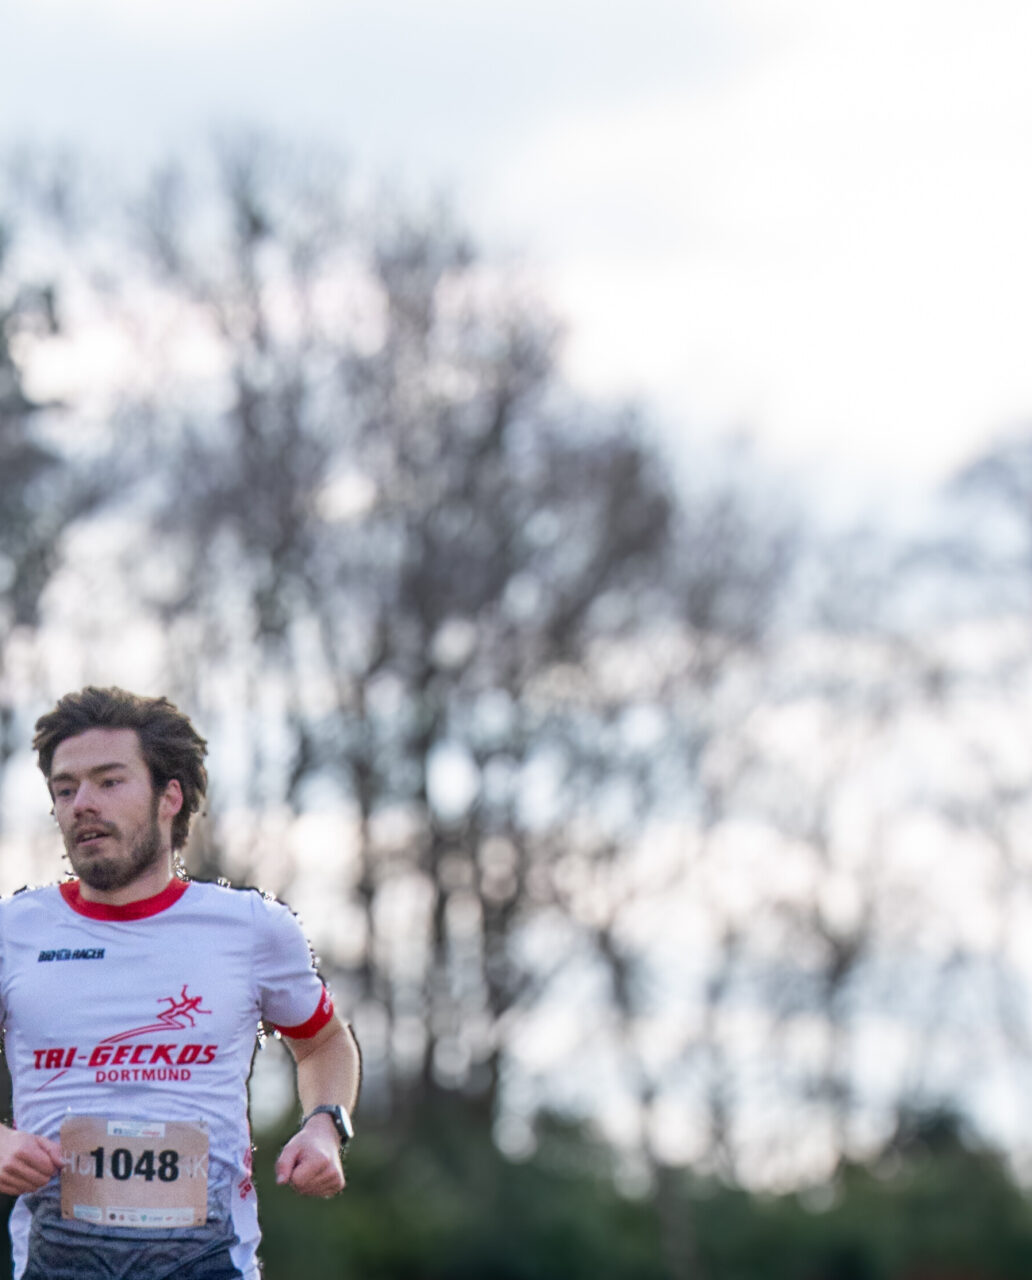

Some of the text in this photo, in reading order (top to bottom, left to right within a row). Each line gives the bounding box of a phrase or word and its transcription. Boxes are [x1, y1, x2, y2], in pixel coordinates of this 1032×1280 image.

[33, 1044, 218, 1070] TRI-GECKOS
[95, 1068, 192, 1083] DORTMUND
[90, 1146, 180, 1183] 1048
